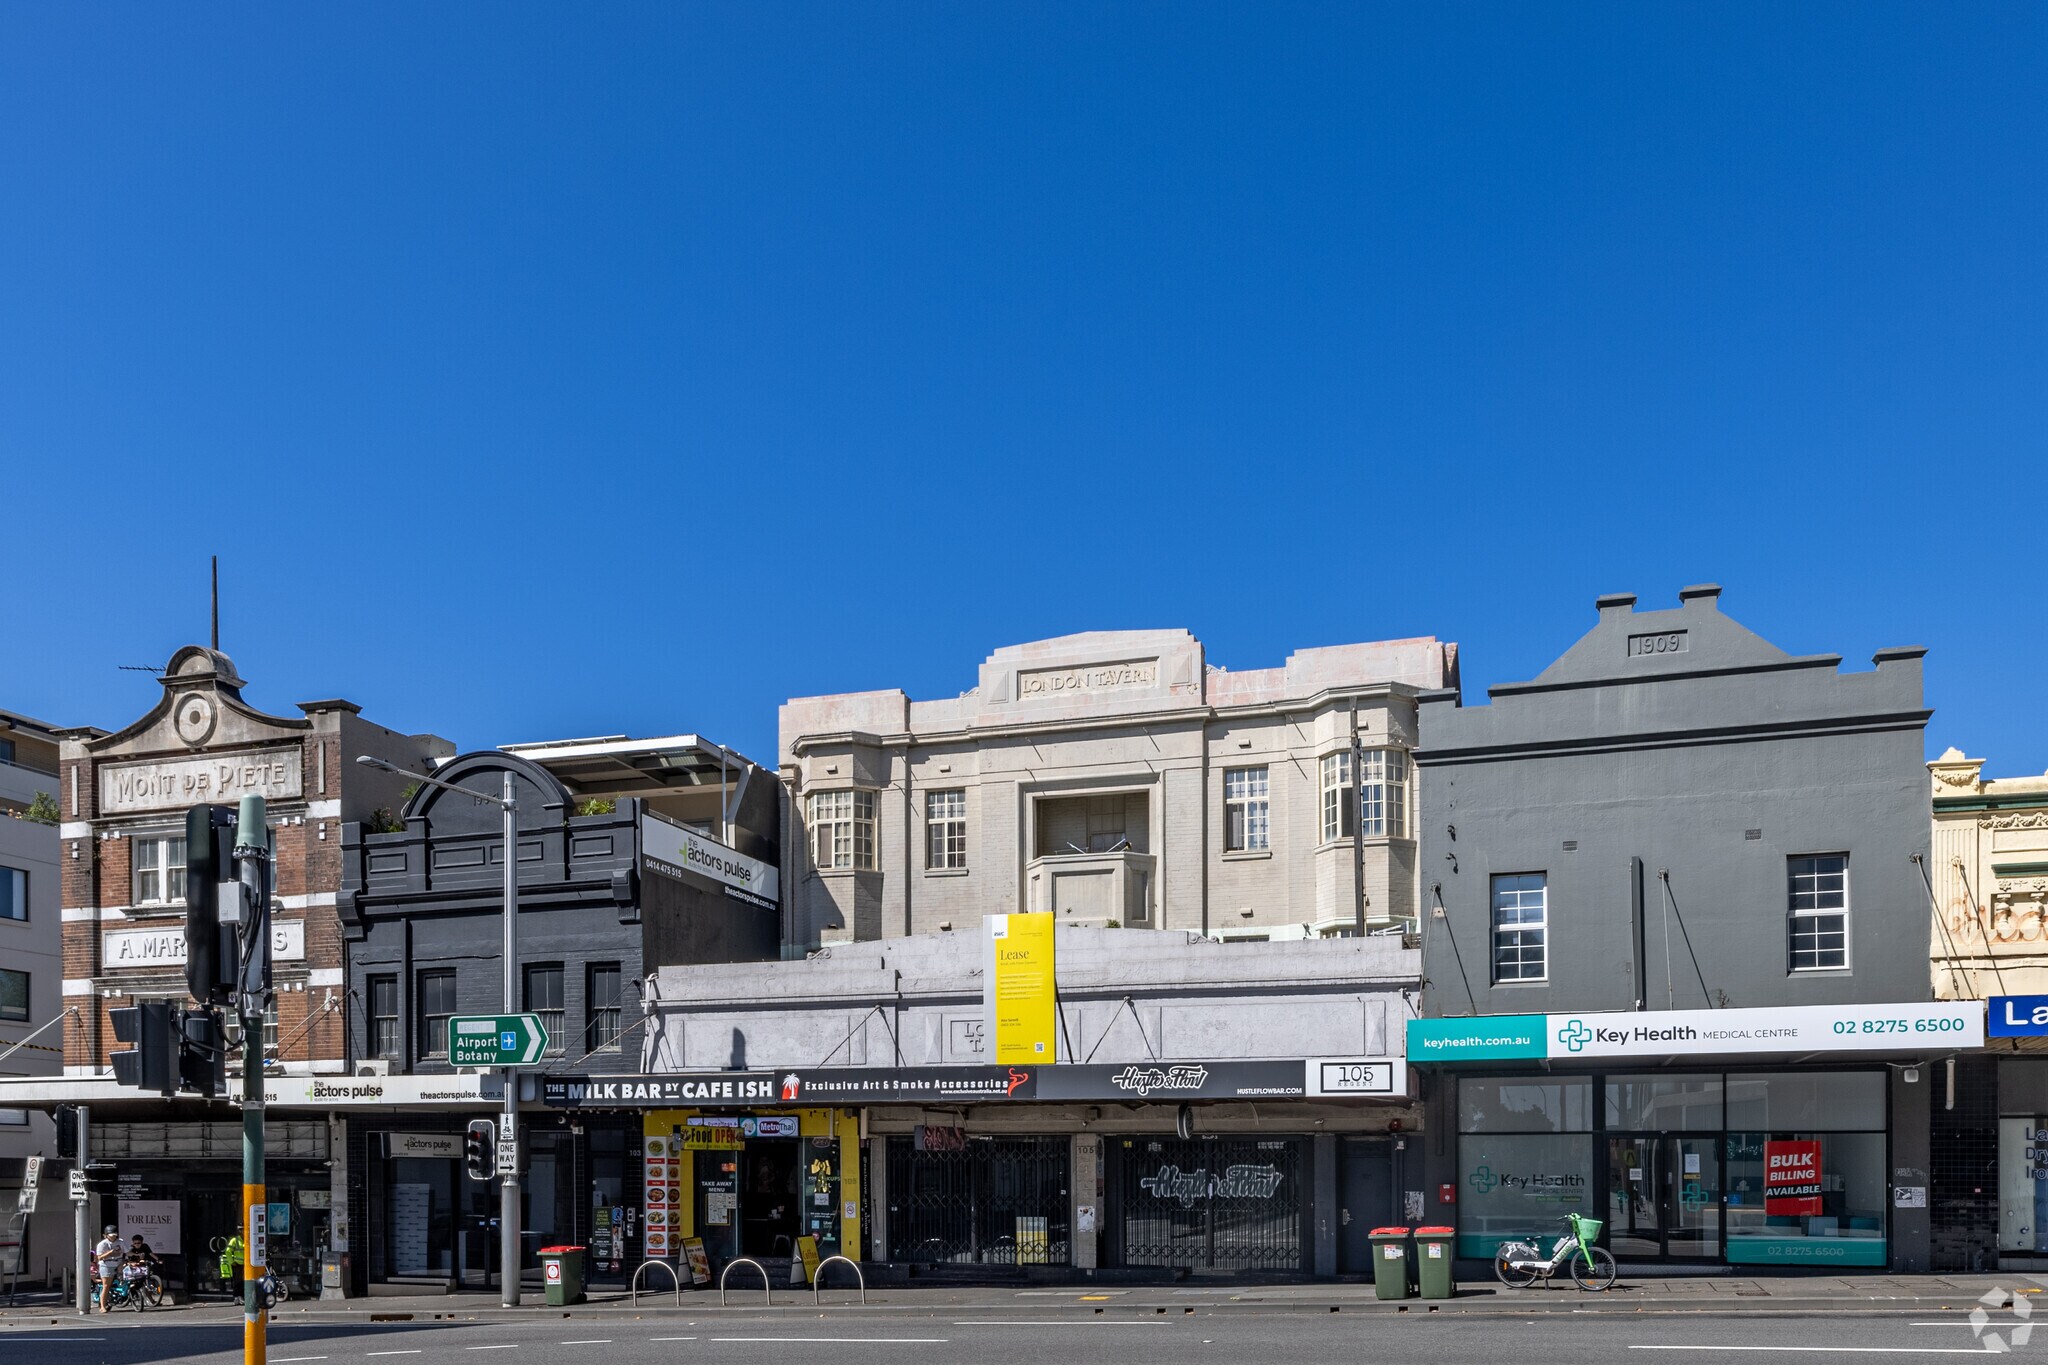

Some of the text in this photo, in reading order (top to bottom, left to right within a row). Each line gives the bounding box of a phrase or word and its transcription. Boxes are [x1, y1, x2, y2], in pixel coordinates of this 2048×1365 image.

[1637, 634, 1680, 655] 1909
[1023, 666, 1156, 693] LONDON TAVERN
[117, 762, 286, 803] MONT DE PIETE
[688, 836, 698, 848] the
[646, 858, 682, 878] 0414 475 515
[688, 847, 751, 881] actors pulse
[1000, 950, 1029, 960] Lease
[1833, 1018, 1965, 1034] 02 8275 6500
[1424, 1036, 1530, 1049] keyhealth.com.au
[1596, 1026, 1799, 1045] Key Health MEDICAL CENTRE
[457, 1037, 498, 1049] Airport
[457, 1051, 498, 1063] Botany
[1338, 1066, 1374, 1082] 105
[314, 1084, 383, 1099] actors pulse
[546, 1081, 773, 1099] THE MILK BAR BY CAFE ISH
[805, 1079, 1009, 1090] Exclusive Art & Smoke Accessories
[1237, 1087, 1302, 1095] HUSTLEFLOWBAR.COM
[692, 1128, 736, 1143] Food OPEN
[410, 1140, 451, 1150] actors pulse
[1770, 1153, 1814, 1167] BULK
[1501, 1174, 1584, 1188] Key Health
[1770, 1170, 1815, 1181] BILLING
[1766, 1185, 1821, 1196] AVAILABLE.
[127, 1215, 172, 1224] FOR LEASE
[1768, 1247, 1844, 1256] 02 8275 6500
